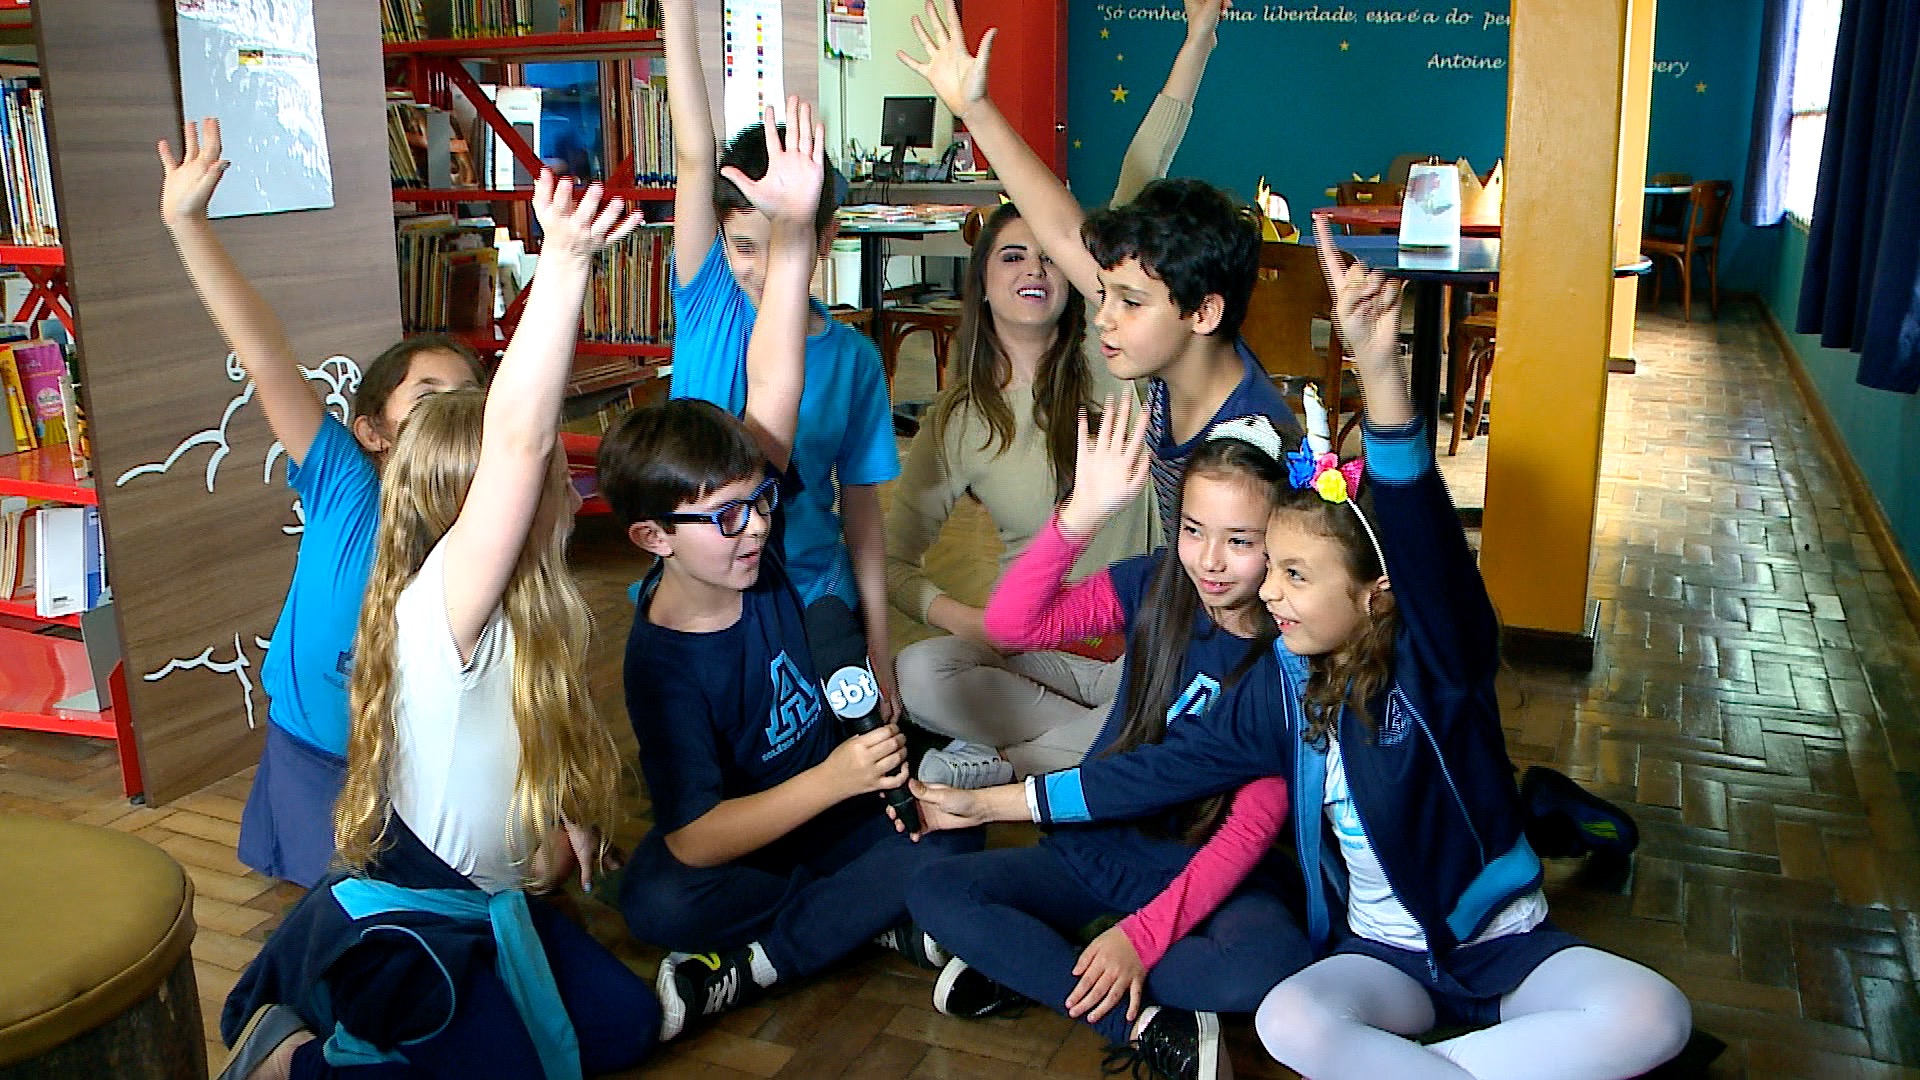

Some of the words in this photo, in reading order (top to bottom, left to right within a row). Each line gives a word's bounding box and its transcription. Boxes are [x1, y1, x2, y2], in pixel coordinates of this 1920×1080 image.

[1366, 9, 1406, 24] essa
[1423, 11, 1439, 24] a
[1445, 8, 1473, 25] do
[1427, 52, 1506, 69] Antoine
[1653, 61, 1689, 78] ery
[829, 673, 876, 710] sbt
